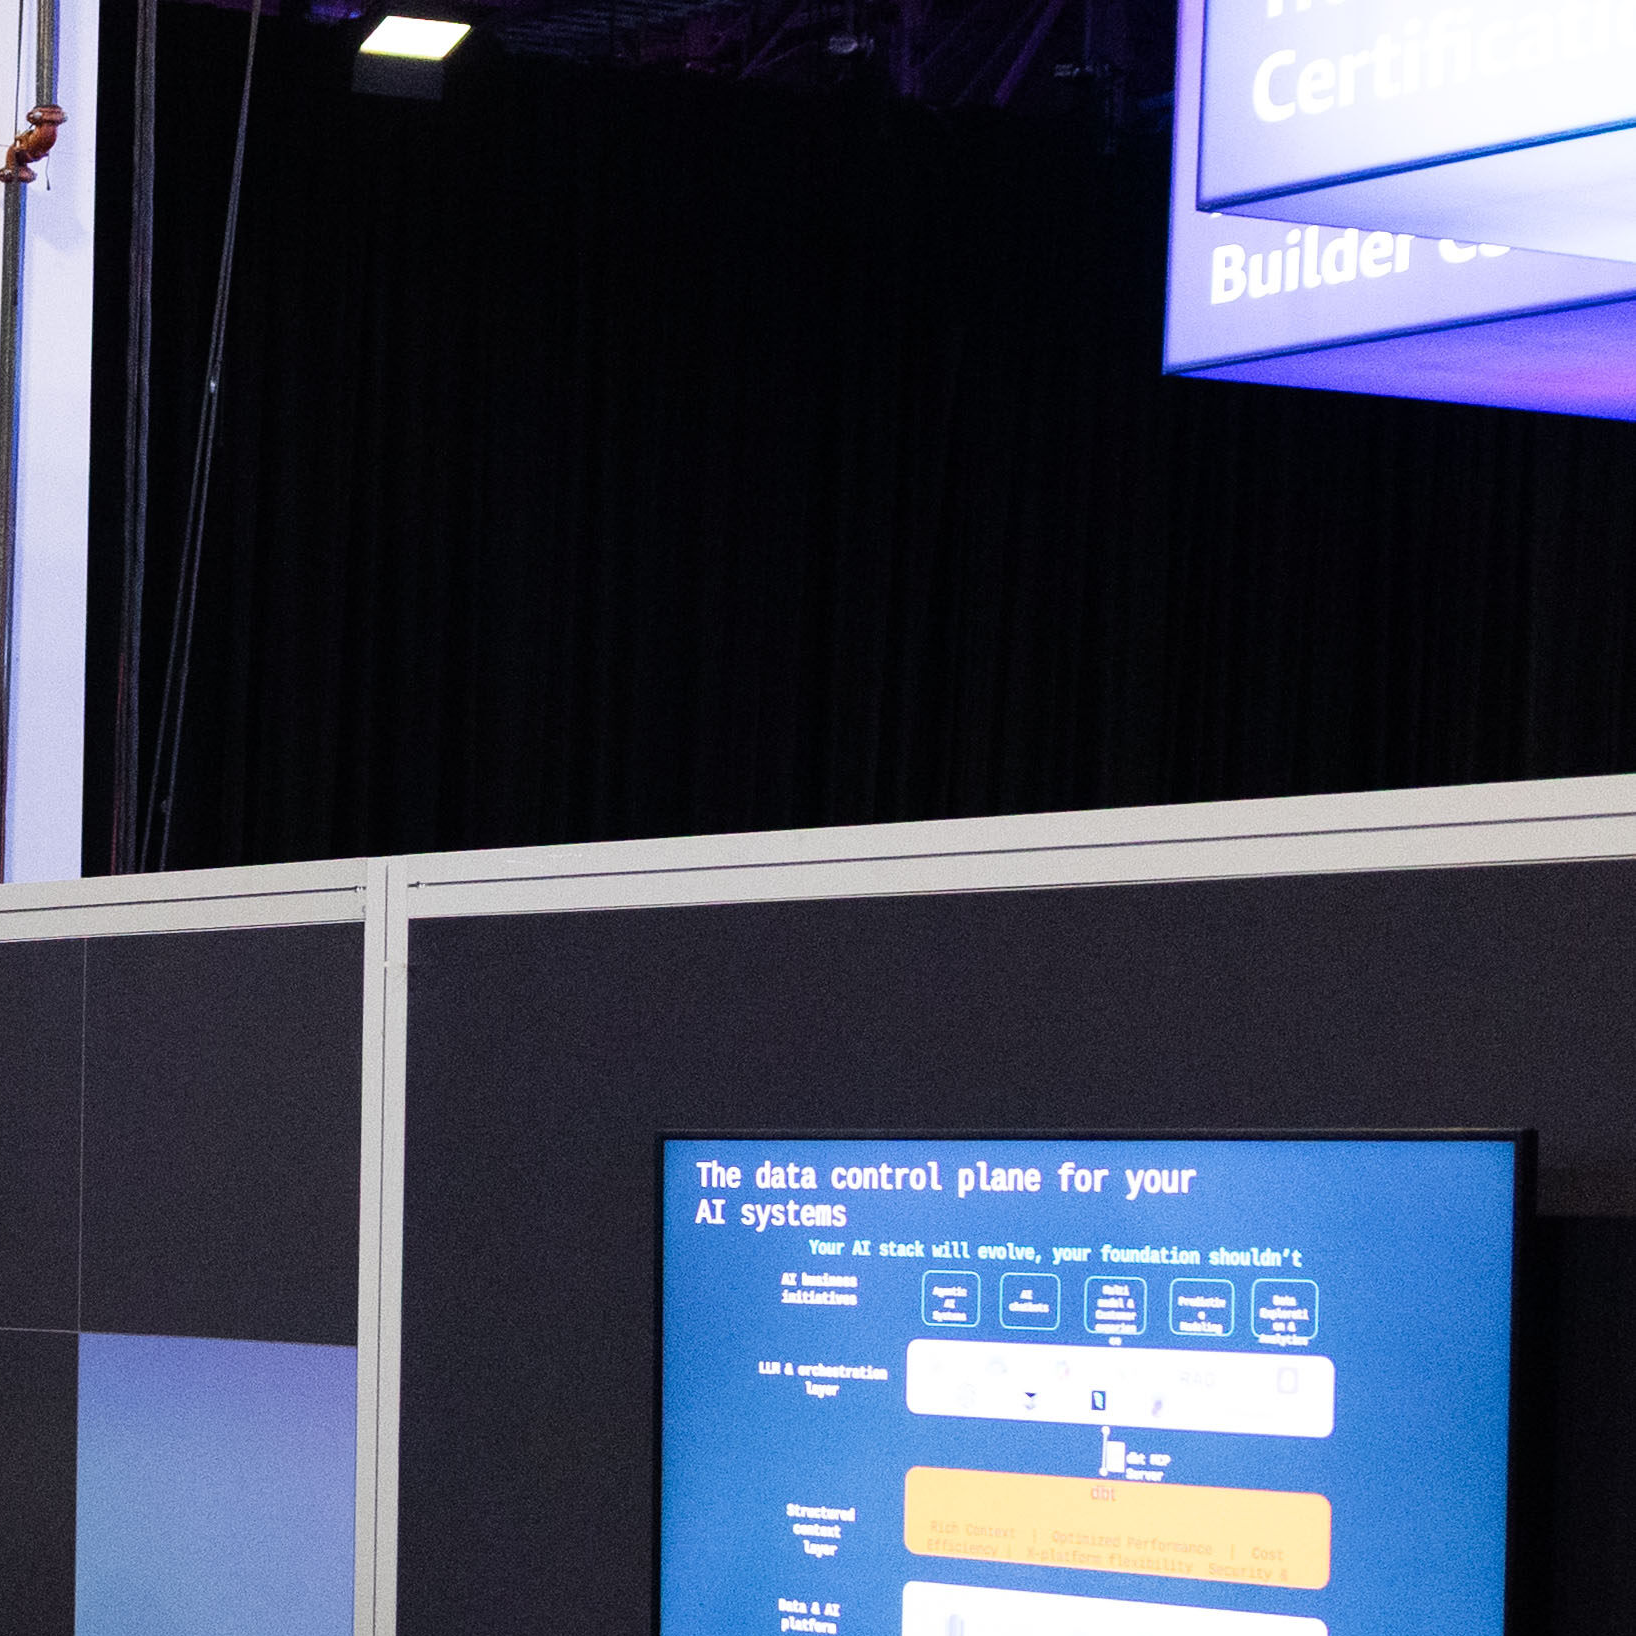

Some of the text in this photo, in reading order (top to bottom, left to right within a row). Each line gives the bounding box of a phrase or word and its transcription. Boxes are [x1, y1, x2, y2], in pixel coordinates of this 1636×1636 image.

[1210, 224, 1416, 305] Builder
[697, 1160, 1196, 1200] The data control plane for your
[696, 1199, 847, 1232] AI systems
[809, 1240, 844, 1255] Your
[853, 1241, 870, 1255] AI
[880, 1241, 924, 1256] stack
[932, 1242, 969, 1258] will
[978, 1243, 1043, 1263] evolve,
[1053, 1248, 1091, 1264] your
[1101, 1245, 1200, 1264] foundation
[781, 1272, 857, 1287] AI business
[782, 1290, 857, 1305] initiatives
[784, 1363, 793, 1375] &
[798, 1363, 888, 1380] orchestration
[805, 1381, 839, 1398] layer
[787, 1503, 855, 1521] Structured
[793, 1524, 841, 1538] context
[803, 1540, 837, 1558] layer
[930, 1520, 960, 1535] Rich
[1126, 1535, 1213, 1556] Performance
[1251, 1545, 1285, 1562] Cost
[926, 1537, 998, 1558] Efficiency
[1107, 1551, 1194, 1575] flexibility
[1208, 1562, 1272, 1582] Security
[779, 1599, 840, 1616] Data & AI
[781, 1615, 837, 1634] platform
